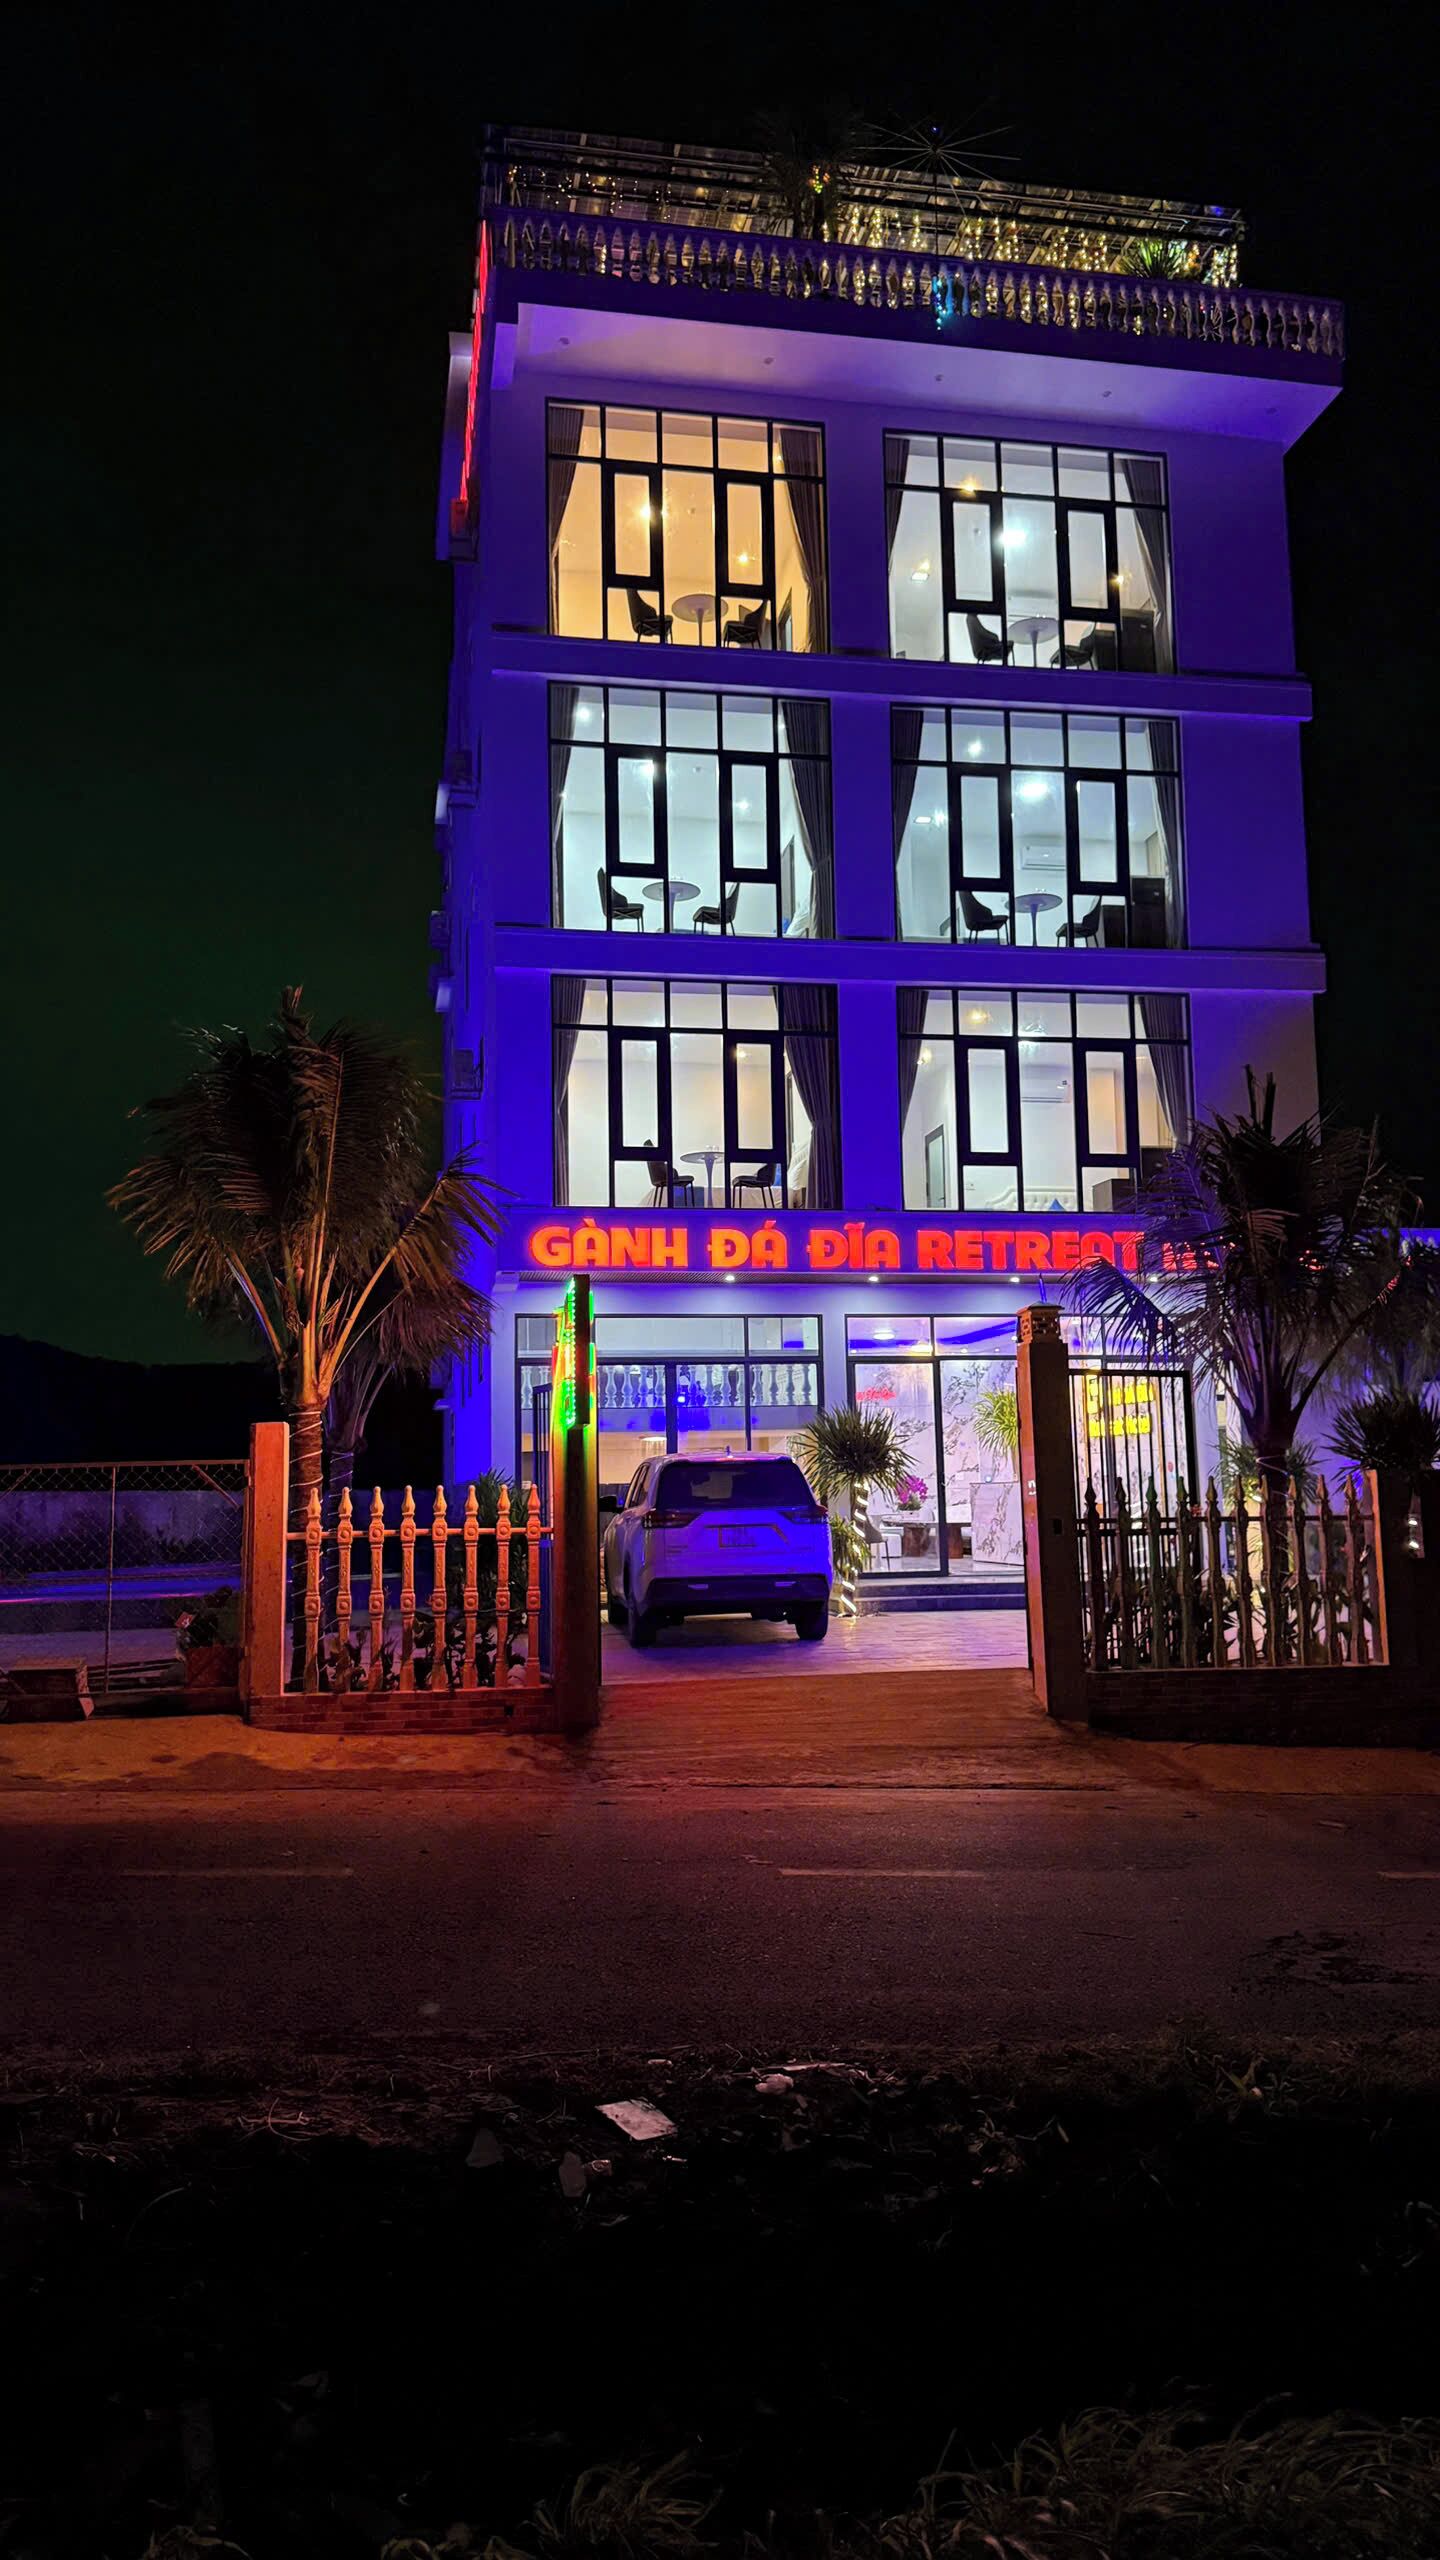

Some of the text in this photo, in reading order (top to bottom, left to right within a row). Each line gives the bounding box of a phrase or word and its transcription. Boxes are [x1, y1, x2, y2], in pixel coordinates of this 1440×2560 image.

[530, 1217, 689, 1268] GÀNH
[707, 1219, 788, 1268] ĐÁ
[806, 1221, 901, 1269] ĐĨA
[917, 1229, 1144, 1270] RETREAT
